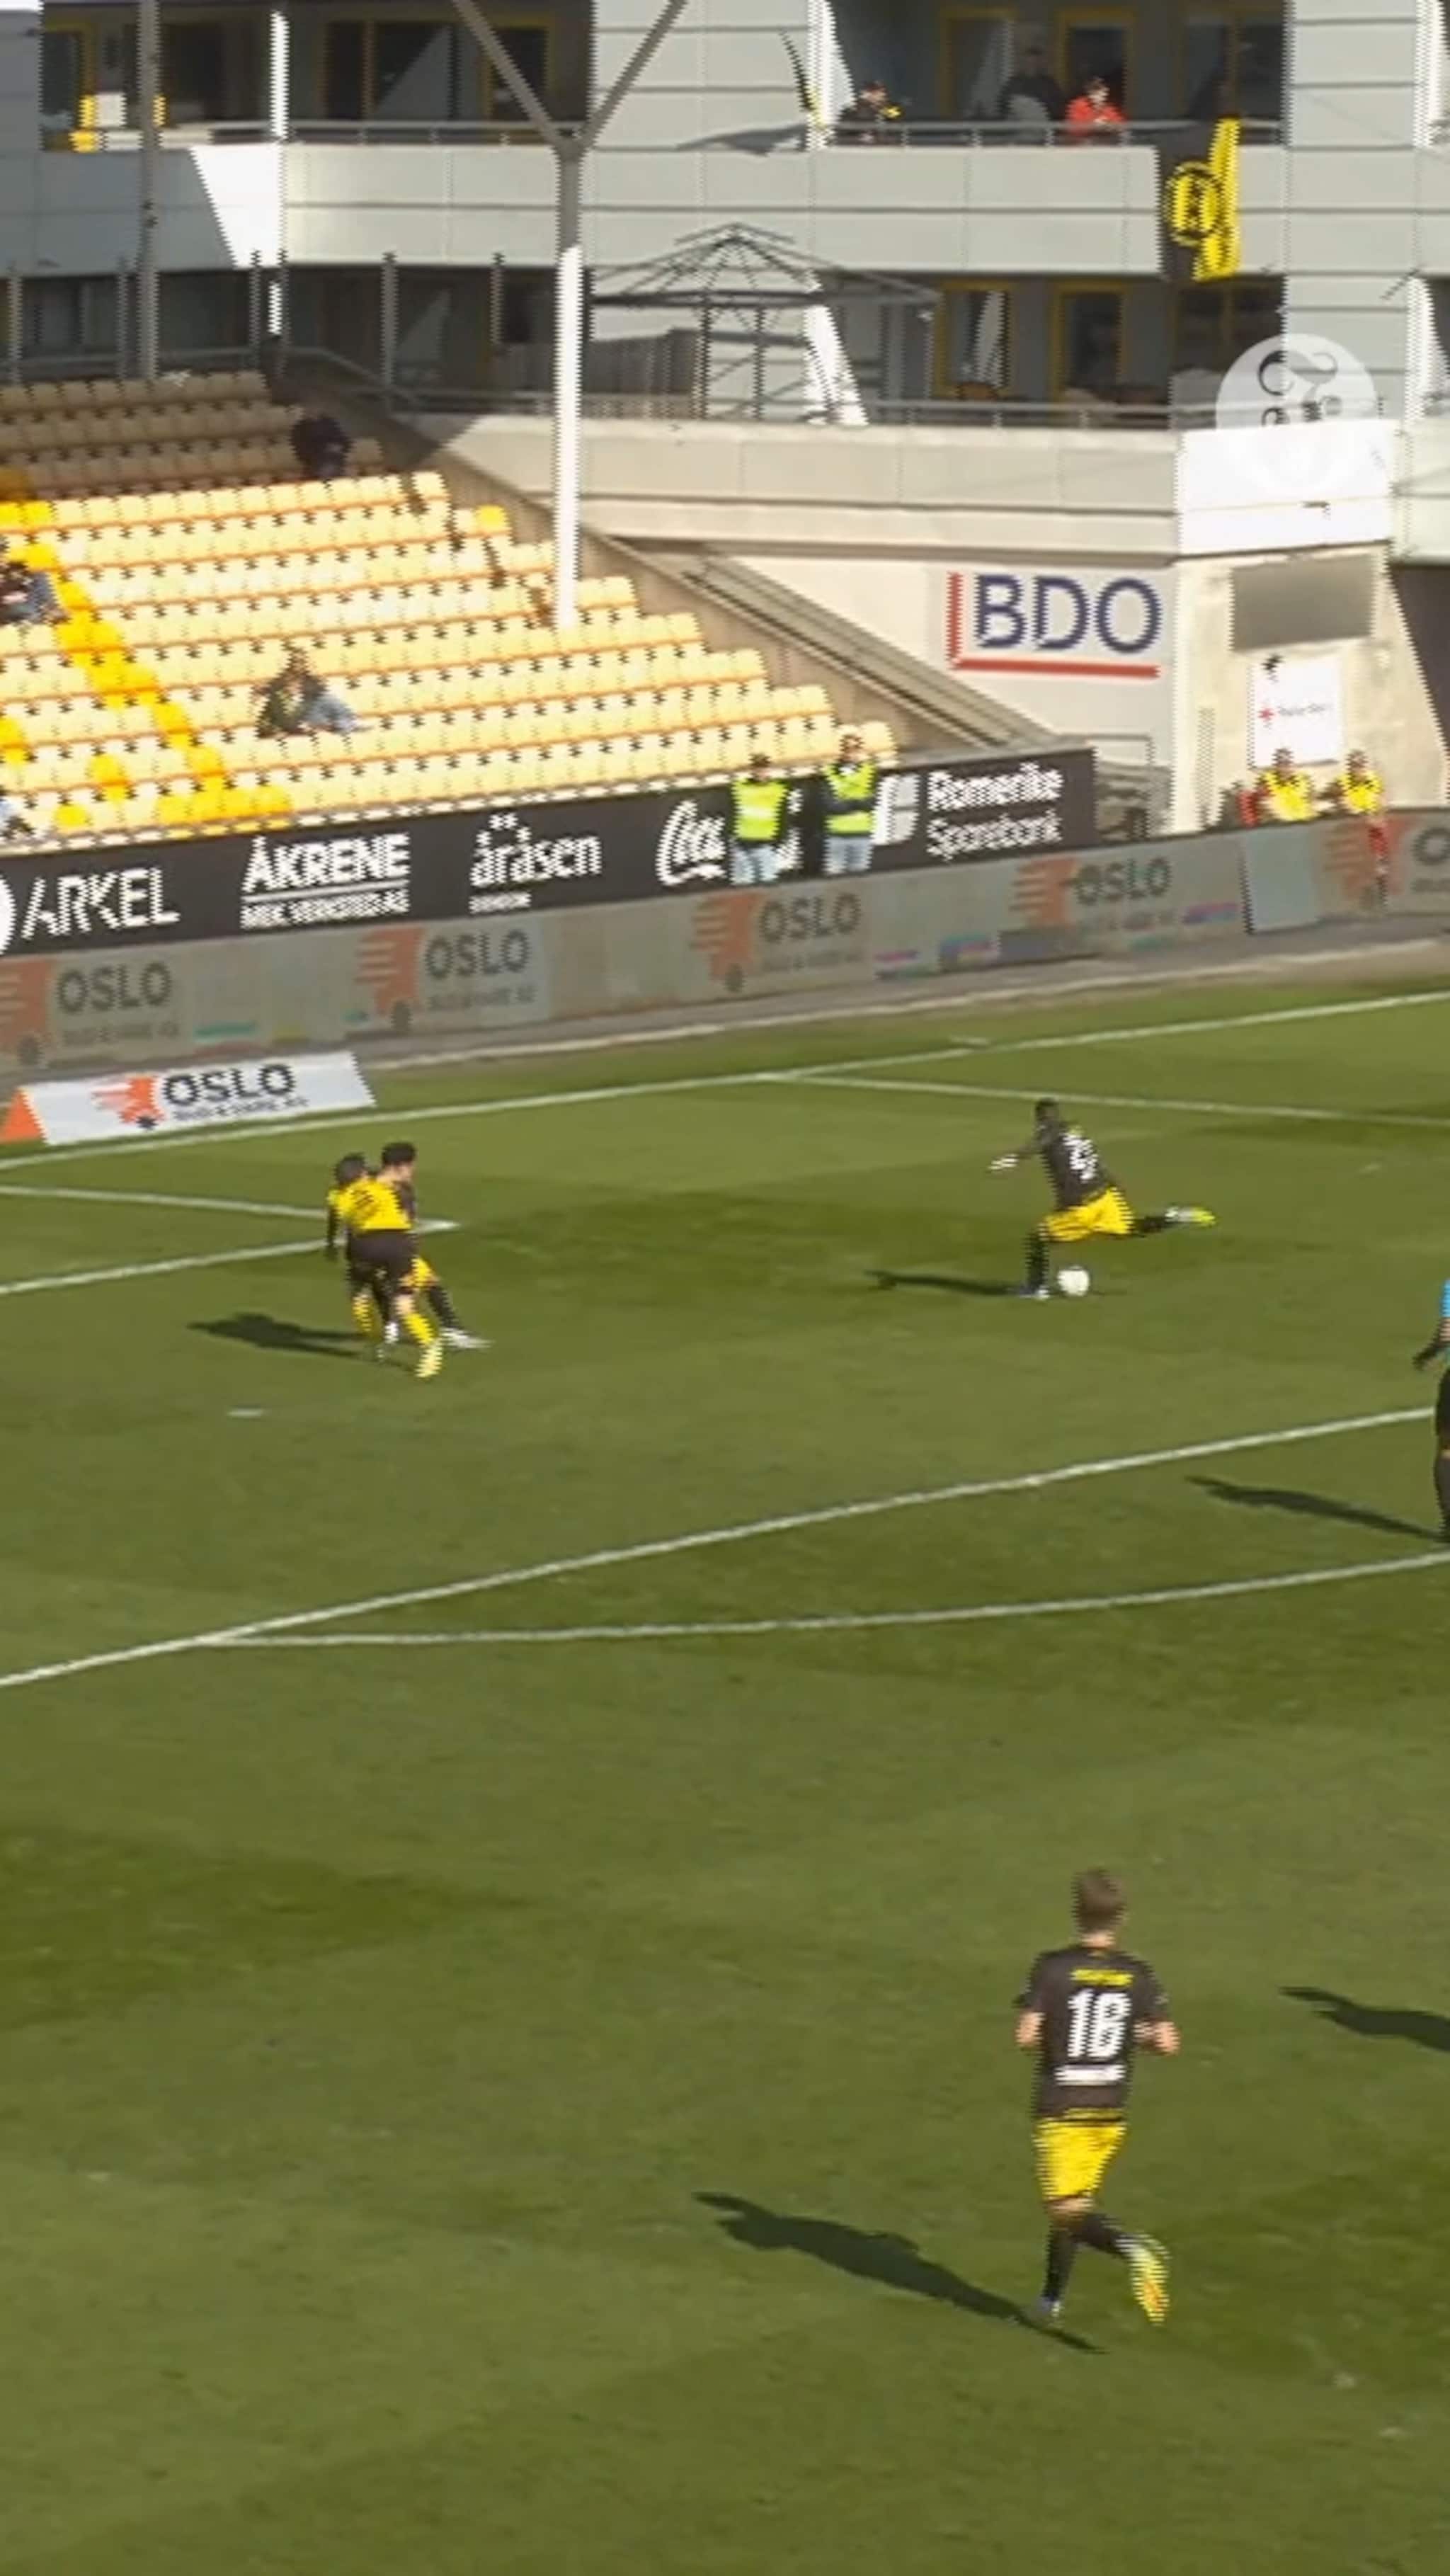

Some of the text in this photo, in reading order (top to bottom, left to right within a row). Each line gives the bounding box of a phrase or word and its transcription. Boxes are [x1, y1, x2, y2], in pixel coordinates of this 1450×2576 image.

[974, 574, 1163, 654] BDO
[242, 833, 410, 893] ÅKRENE
[1075, 856, 1171, 906] OSLO
[21, 865, 181, 940] ARKEL
[760, 892, 861, 942] OSLO
[426, 929, 530, 980] OSLO
[57, 962, 172, 1013] OSLO
[164, 1063, 295, 1106] OSLO
[1067, 1988, 1131, 2058] 18
